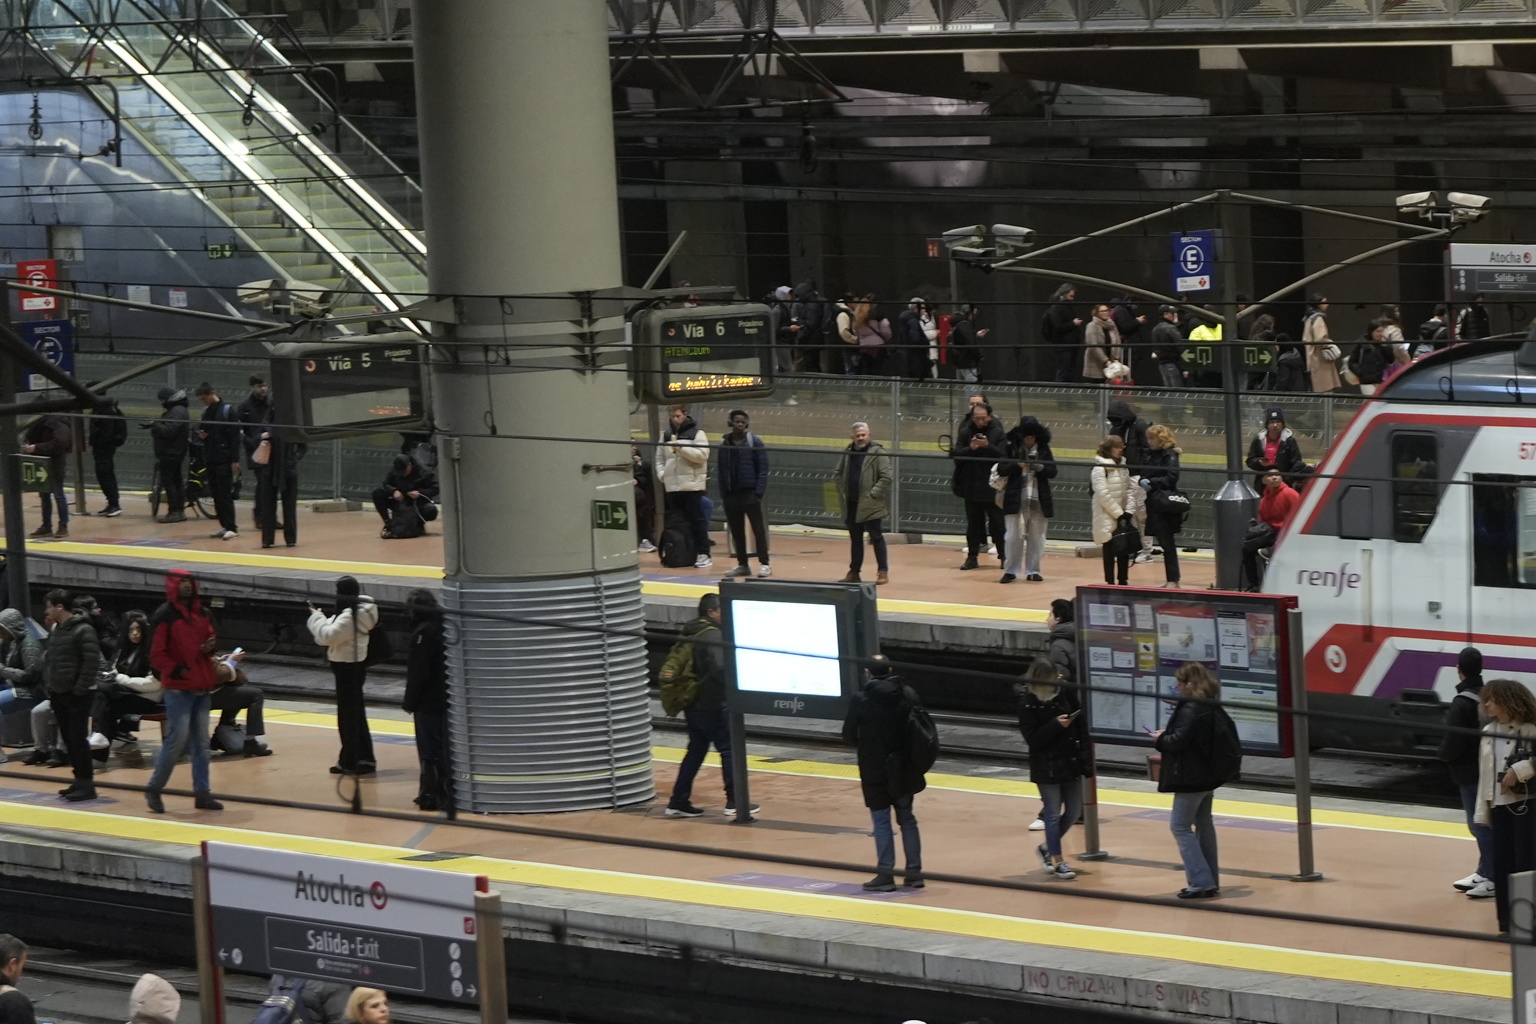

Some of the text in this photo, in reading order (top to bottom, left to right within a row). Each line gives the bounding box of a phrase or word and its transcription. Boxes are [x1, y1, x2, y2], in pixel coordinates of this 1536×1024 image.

[1186, 249, 1198, 270] E
[1489, 251, 1522, 263] Atocha
[716, 321, 725, 336] 6
[361, 352, 372, 368] 5
[1297, 562, 1361, 598] renfe
[774, 696, 805, 714] renfe
[295, 870, 365, 908] Atocha
[1028, 970, 1049, 988] NO
